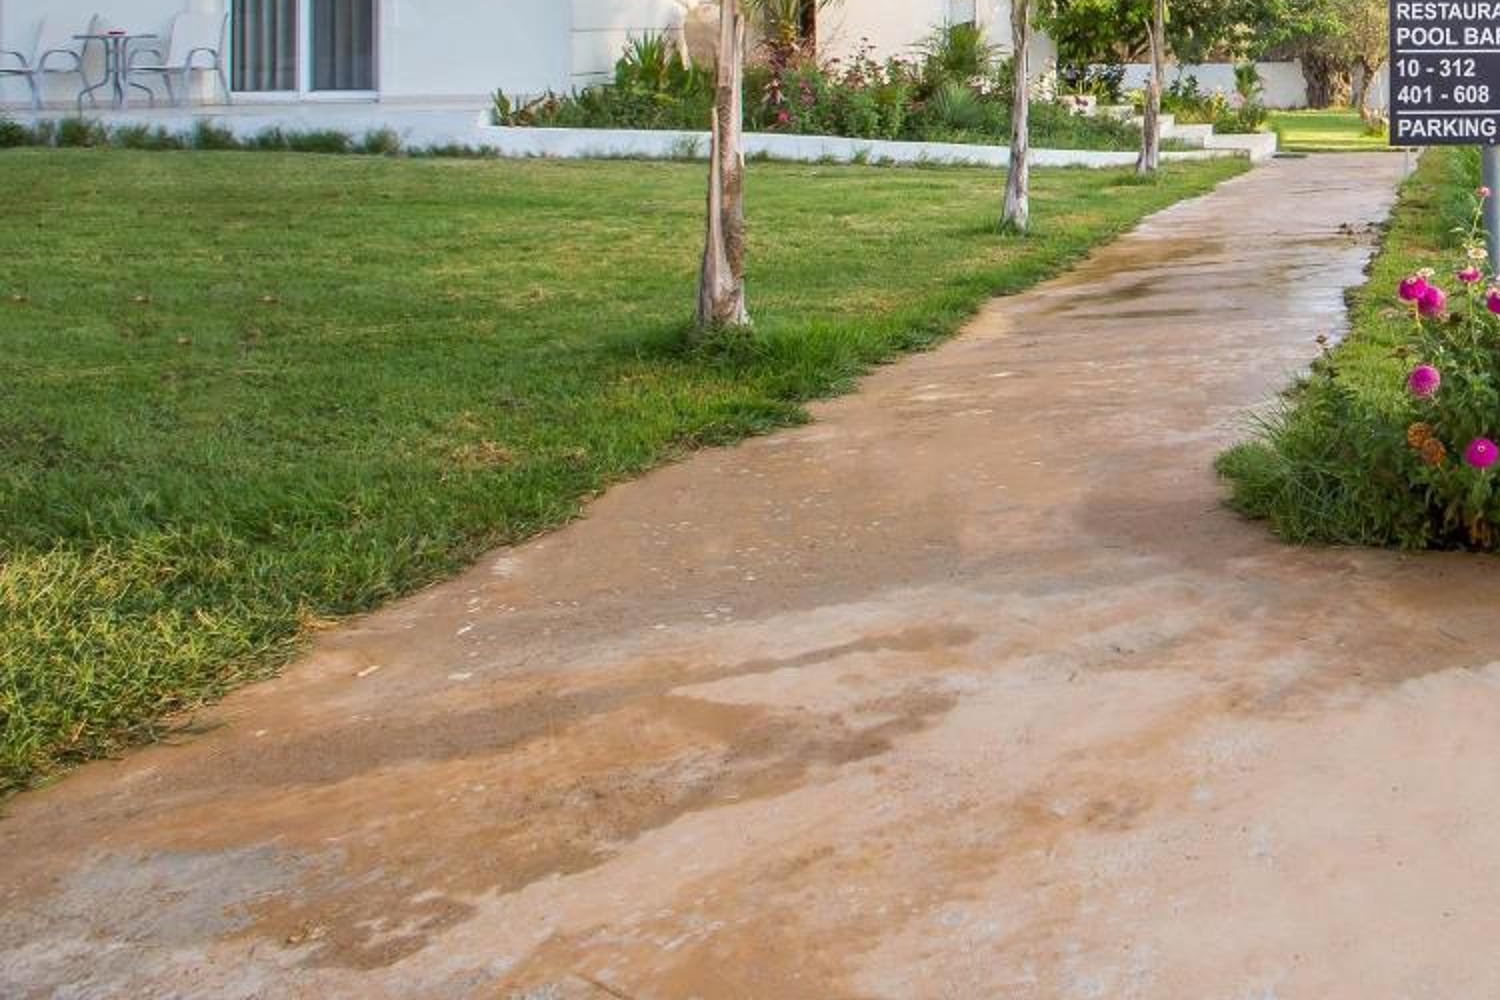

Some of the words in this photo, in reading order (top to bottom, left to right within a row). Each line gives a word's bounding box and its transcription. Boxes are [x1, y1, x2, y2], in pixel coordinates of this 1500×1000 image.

[1396, 27, 1459, 46] POOL
[1396, 59, 1419, 77] 10
[1439, 58, 1476, 77] 312
[1397, 85, 1433, 104] 401
[1453, 85, 1490, 103] 608
[1398, 118, 1497, 137] PARKING
